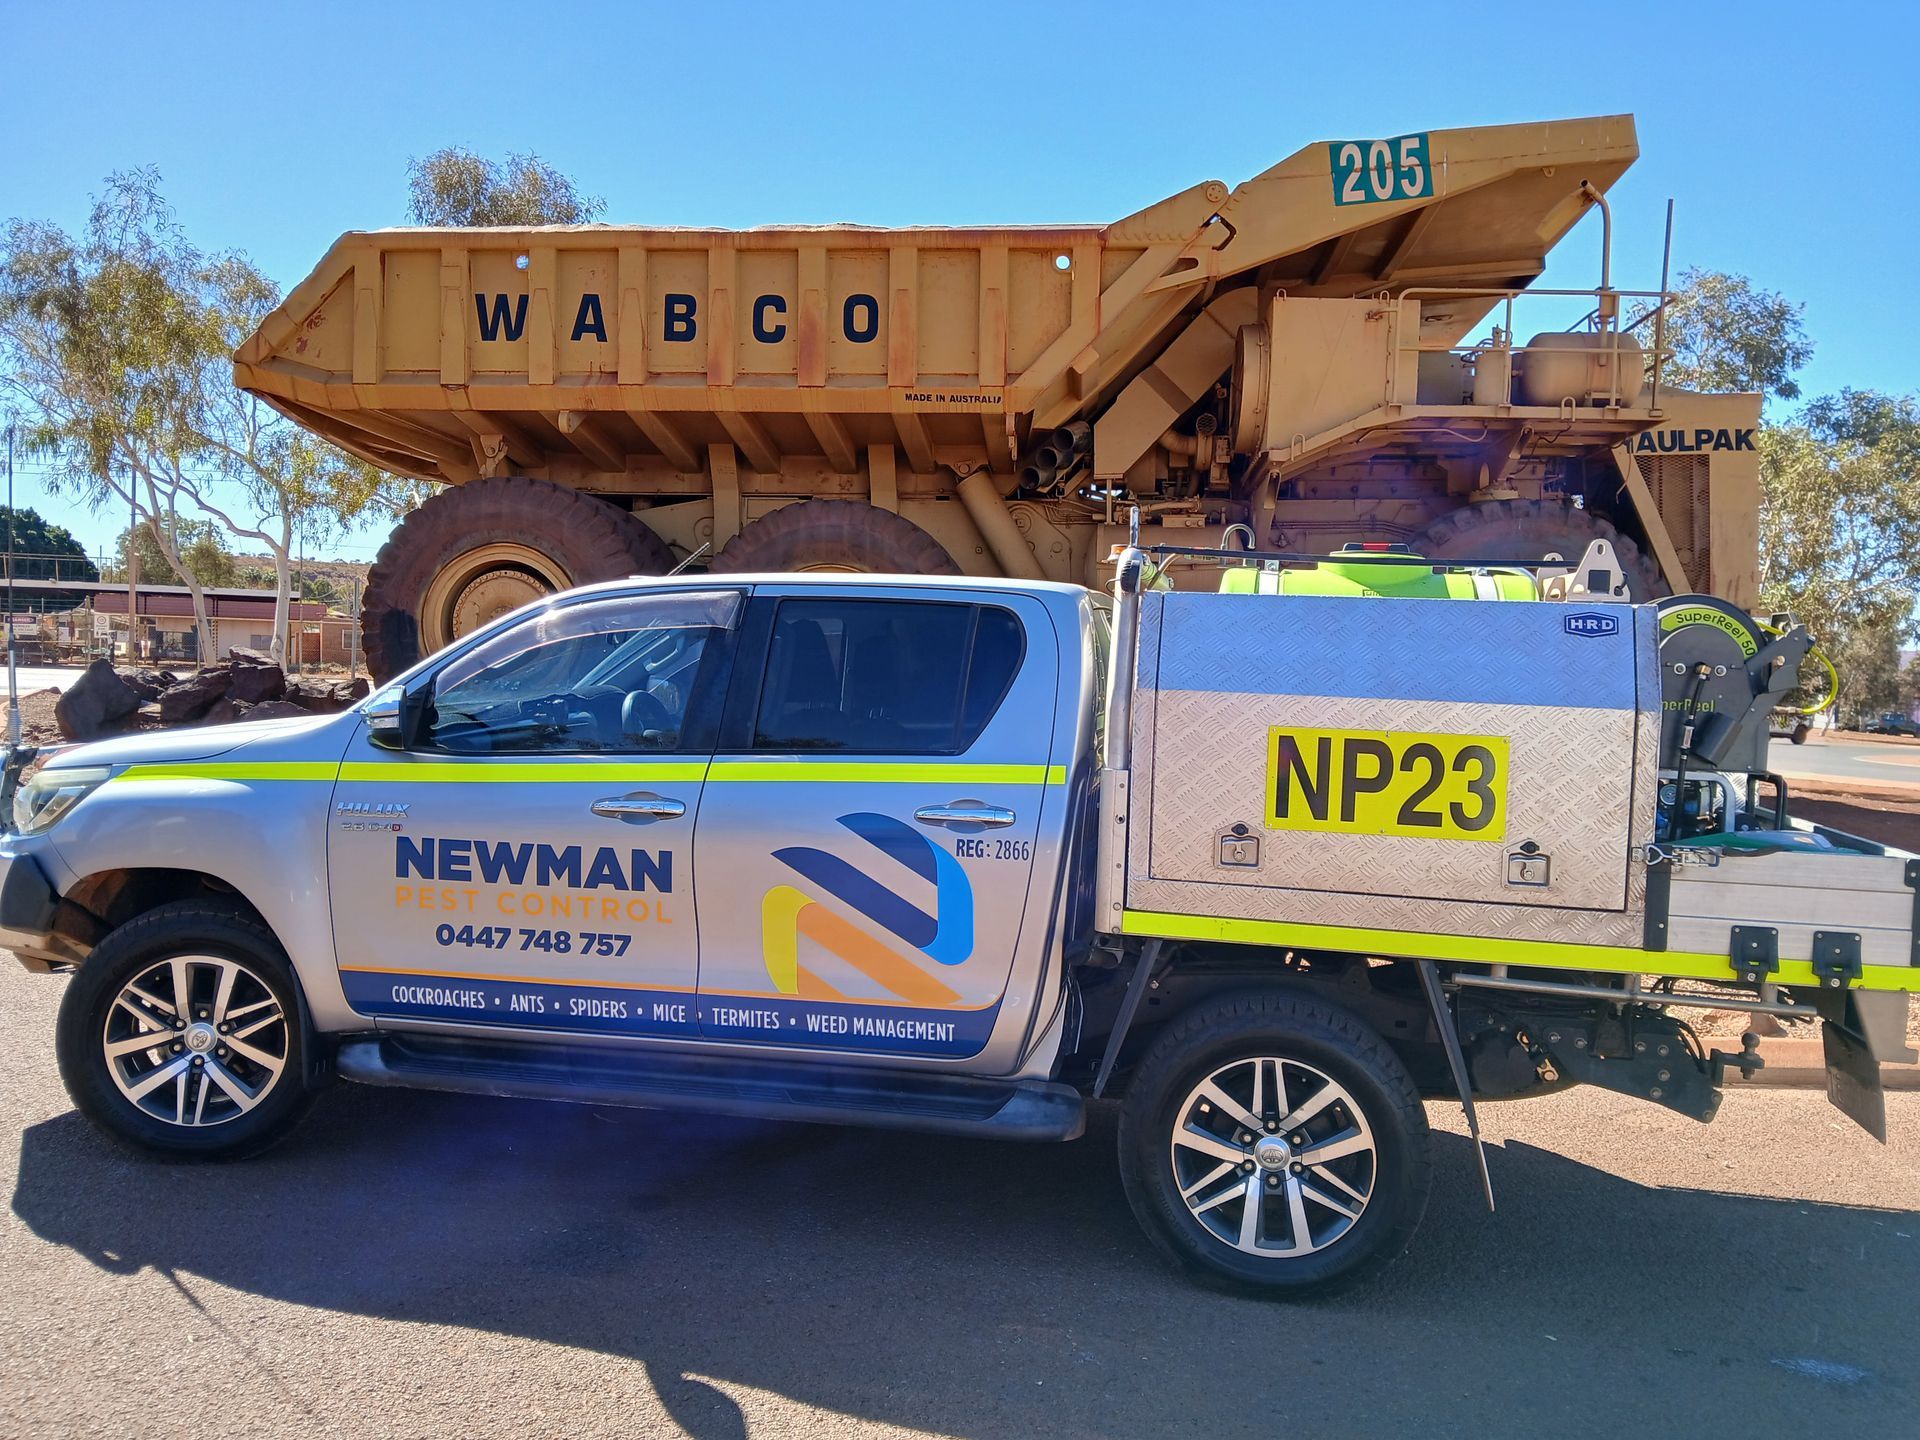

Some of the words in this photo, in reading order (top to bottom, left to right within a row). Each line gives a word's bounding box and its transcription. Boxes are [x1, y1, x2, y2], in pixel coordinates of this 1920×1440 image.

[1339, 137, 1424, 202] 205
[474, 293, 880, 344] WABCO
[905, 393, 932, 402] MADE
[936, 394, 945, 403] IN
[1675, 612, 1746, 639] SuperReel
[1741, 640, 1756, 656] 50
[1275, 735, 1496, 832] NP23
[336, 801, 410, 818] HILUX
[395, 835, 673, 894] NEWMAN
[956, 838, 990, 858] REG:
[995, 839, 1029, 861] 2866
[395, 886, 480, 912] PEST
[497, 891, 673, 924] CONTROL
[435, 923, 512, 950] 0447
[518, 928, 572, 954] 748
[579, 932, 632, 957] 757
[391, 985, 485, 1009] COCKROACHES
[509, 994, 544, 1014] ANTS
[569, 998, 628, 1019] SPIDERS
[653, 1003, 687, 1023] MICE
[712, 1007, 780, 1030] TERMITES
[806, 1014, 848, 1034] WEED
[853, 1016, 955, 1042] MANAGEMENT
